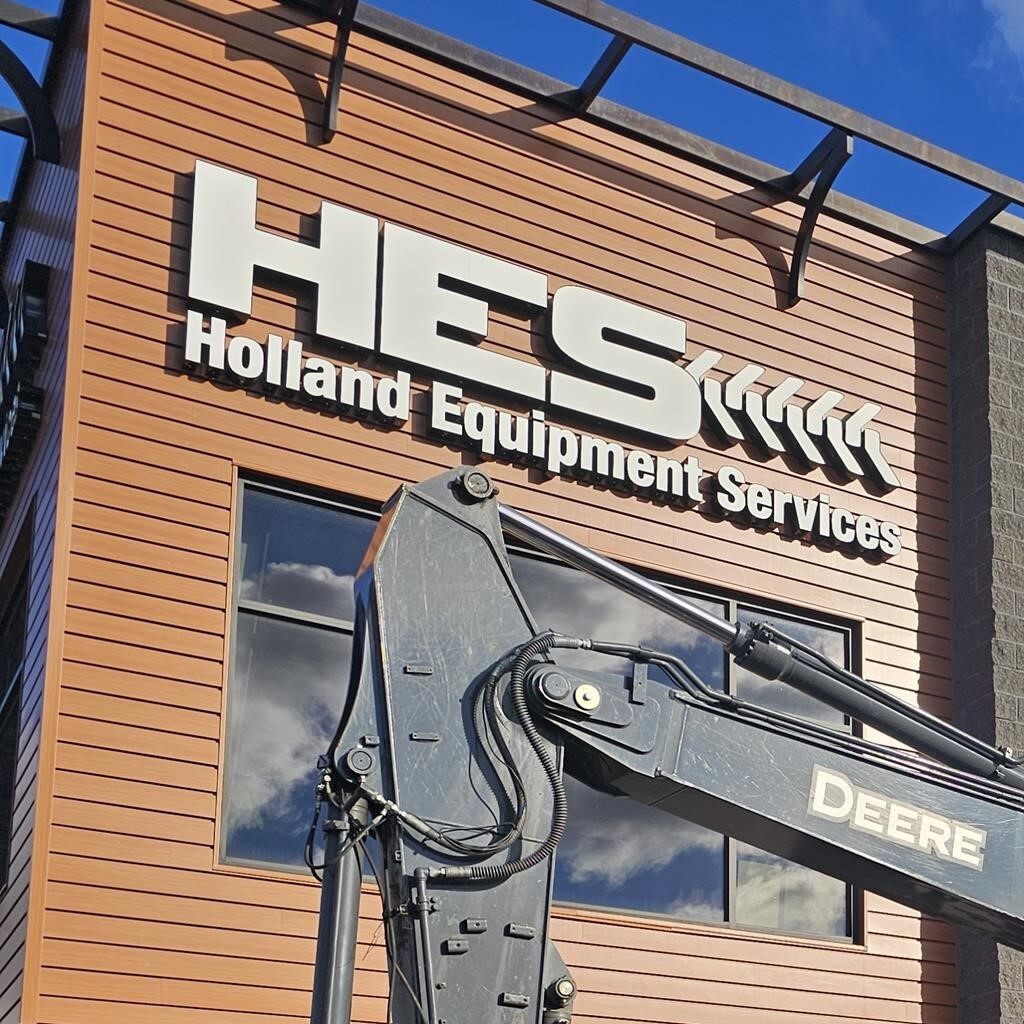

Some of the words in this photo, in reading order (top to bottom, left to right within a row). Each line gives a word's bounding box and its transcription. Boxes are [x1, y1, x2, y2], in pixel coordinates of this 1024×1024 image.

[189, 159, 702, 442] HES
[184, 311, 410, 421] Holland
[431, 381, 705, 503] Equipment
[717, 465, 901, 555] Services
[812, 769, 983, 867] DEERE
